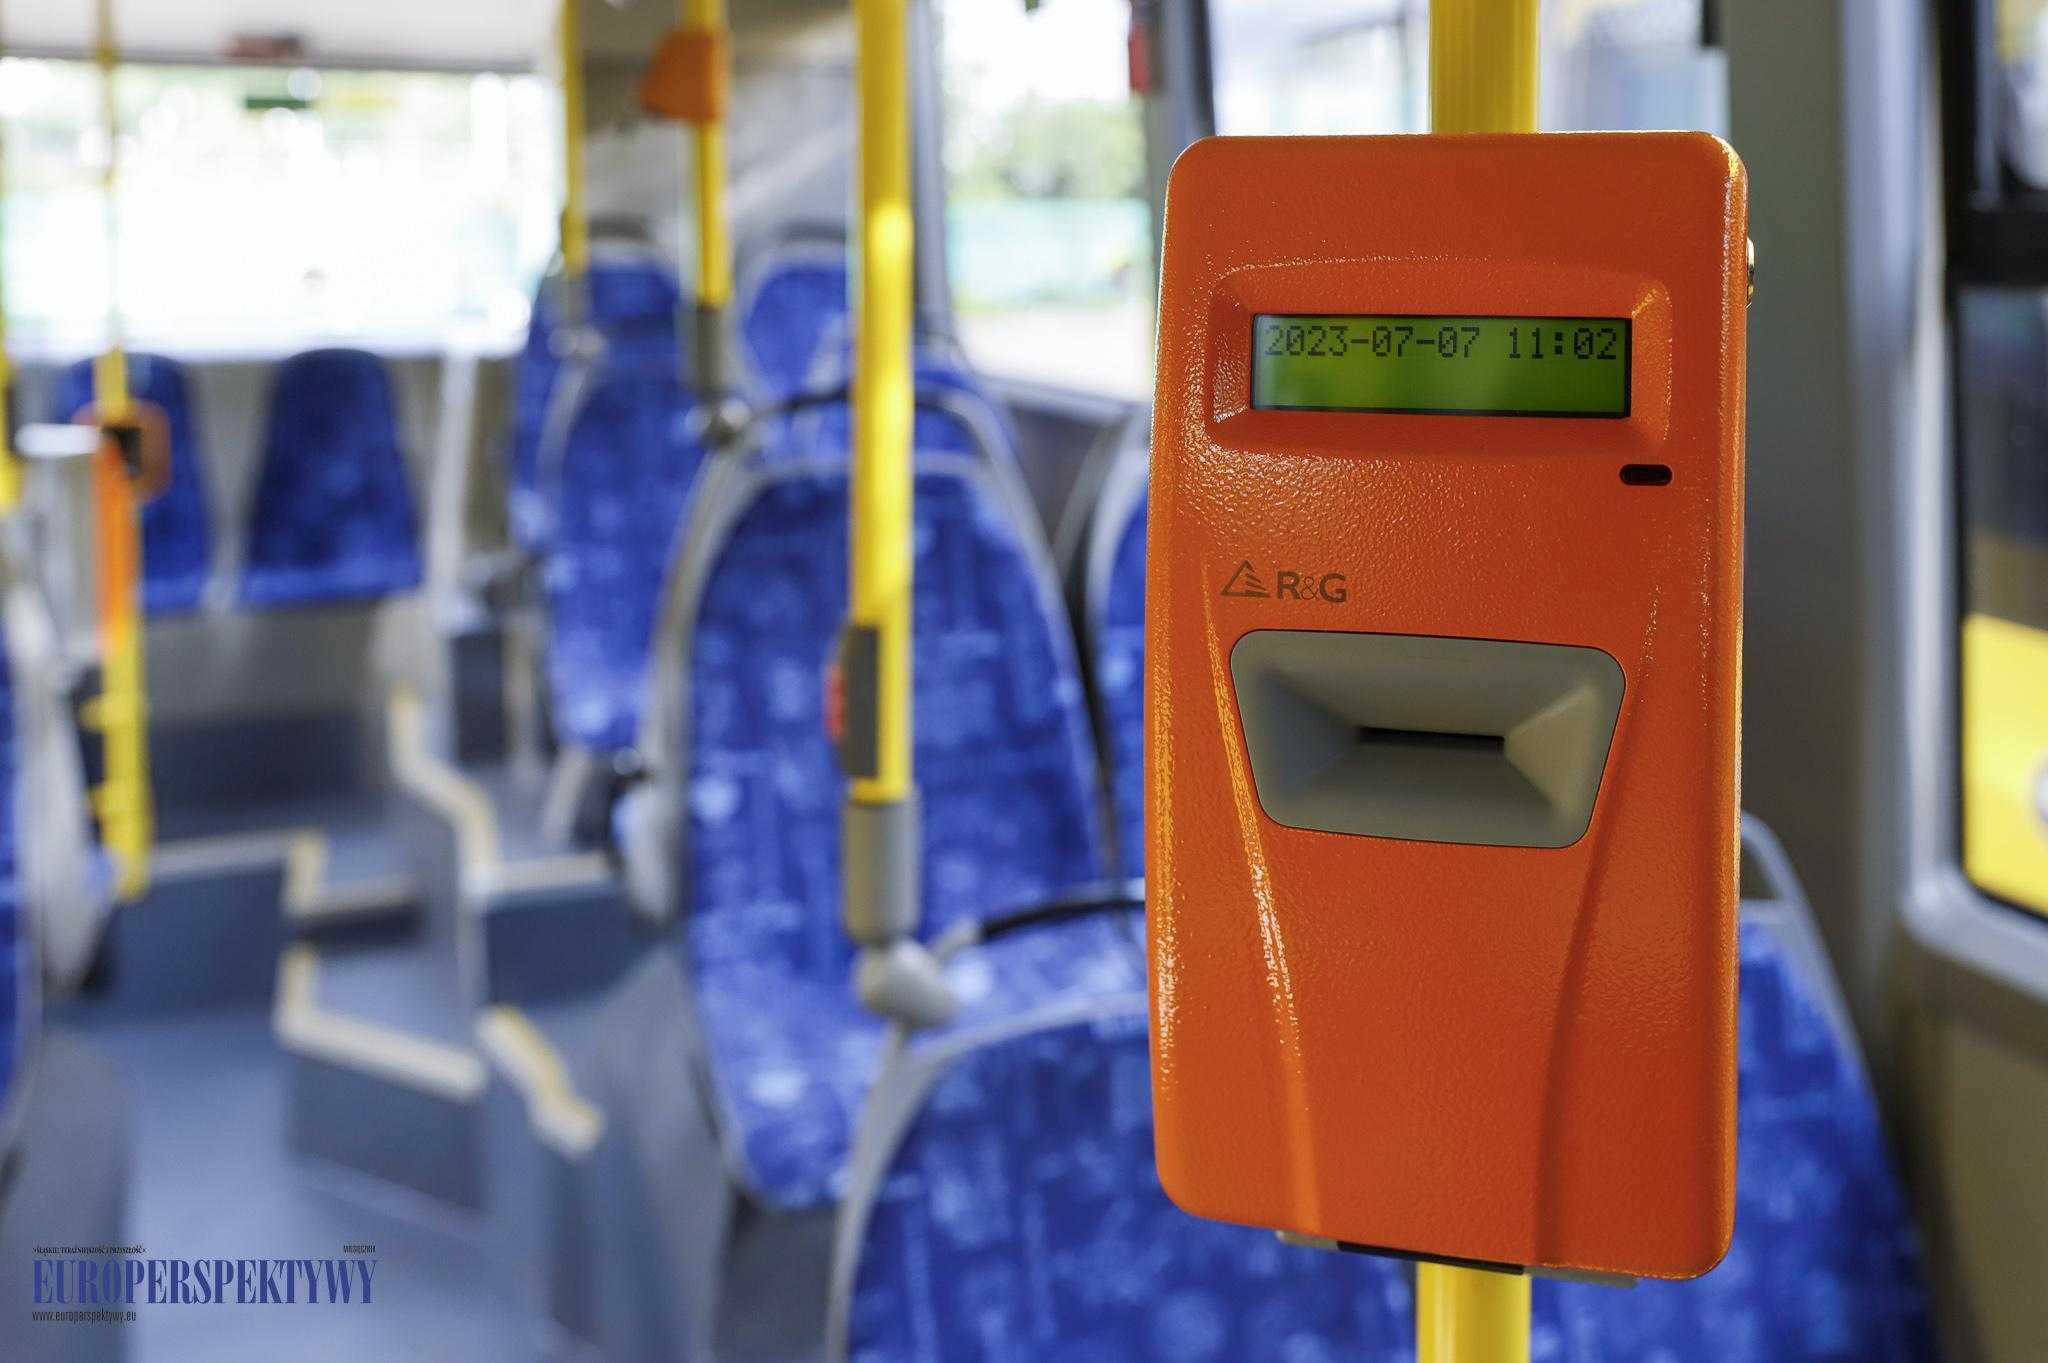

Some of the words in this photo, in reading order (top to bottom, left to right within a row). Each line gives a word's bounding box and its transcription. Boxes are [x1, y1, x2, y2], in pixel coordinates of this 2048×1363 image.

[1265, 325, 1480, 358] 2023-07-07
[1508, 327, 1617, 360] 11:02
[1277, 570, 1347, 603] R&G
